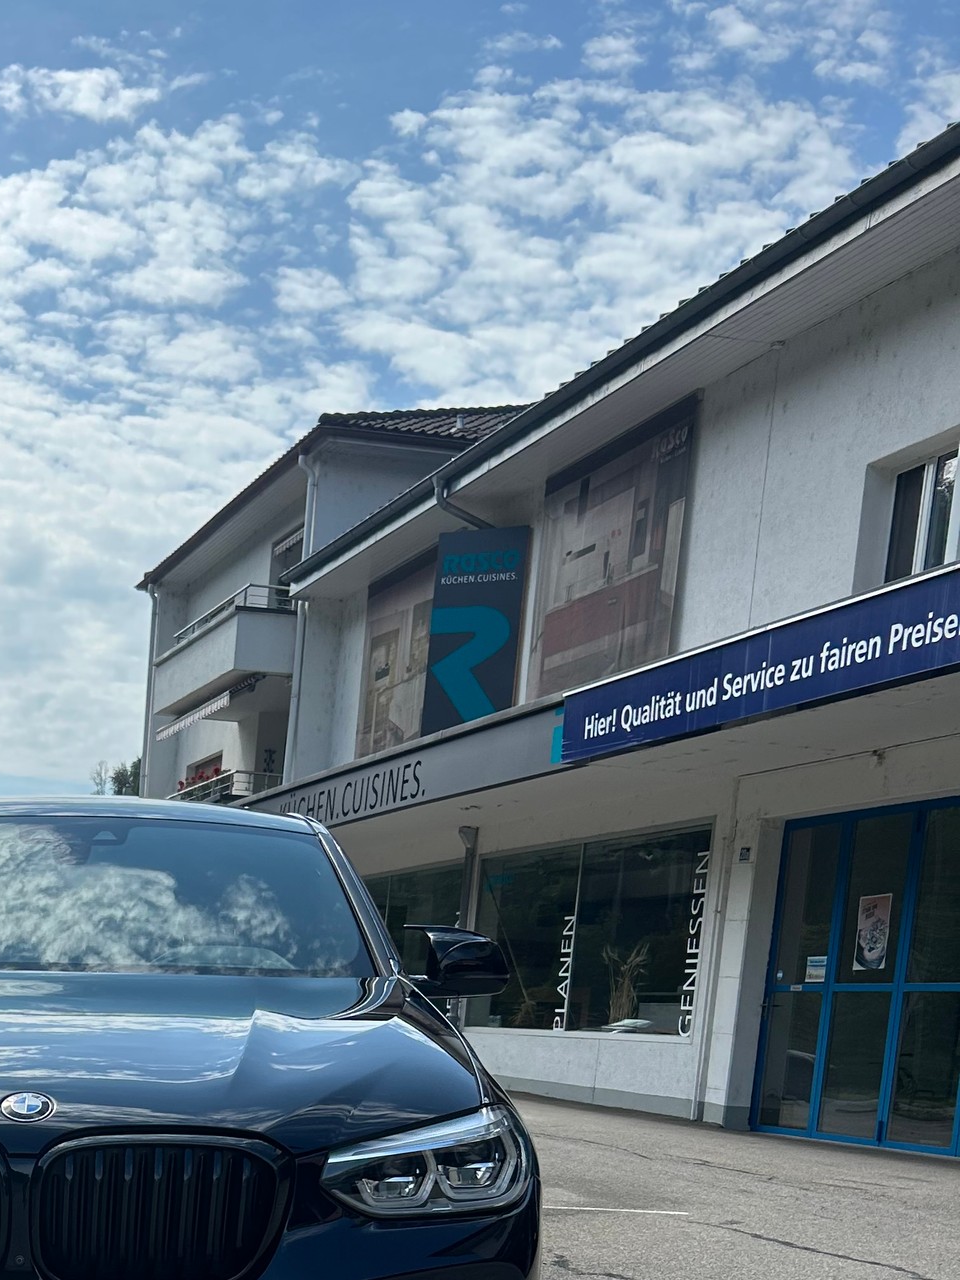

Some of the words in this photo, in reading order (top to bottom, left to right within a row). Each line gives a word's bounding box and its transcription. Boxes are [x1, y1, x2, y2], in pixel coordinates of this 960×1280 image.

[584, 708, 618, 740] Hier!
[620, 690, 682, 733] Qualität
[685, 677, 719, 713] und
[722, 661, 786, 702] Service
[789, 654, 814, 683] zu
[819, 636, 882, 675] fairen
[887, 611, 960, 656] Preise
[553, 915, 576, 1031] PLANEN
[678, 850, 710, 1038] GENIESSEN
